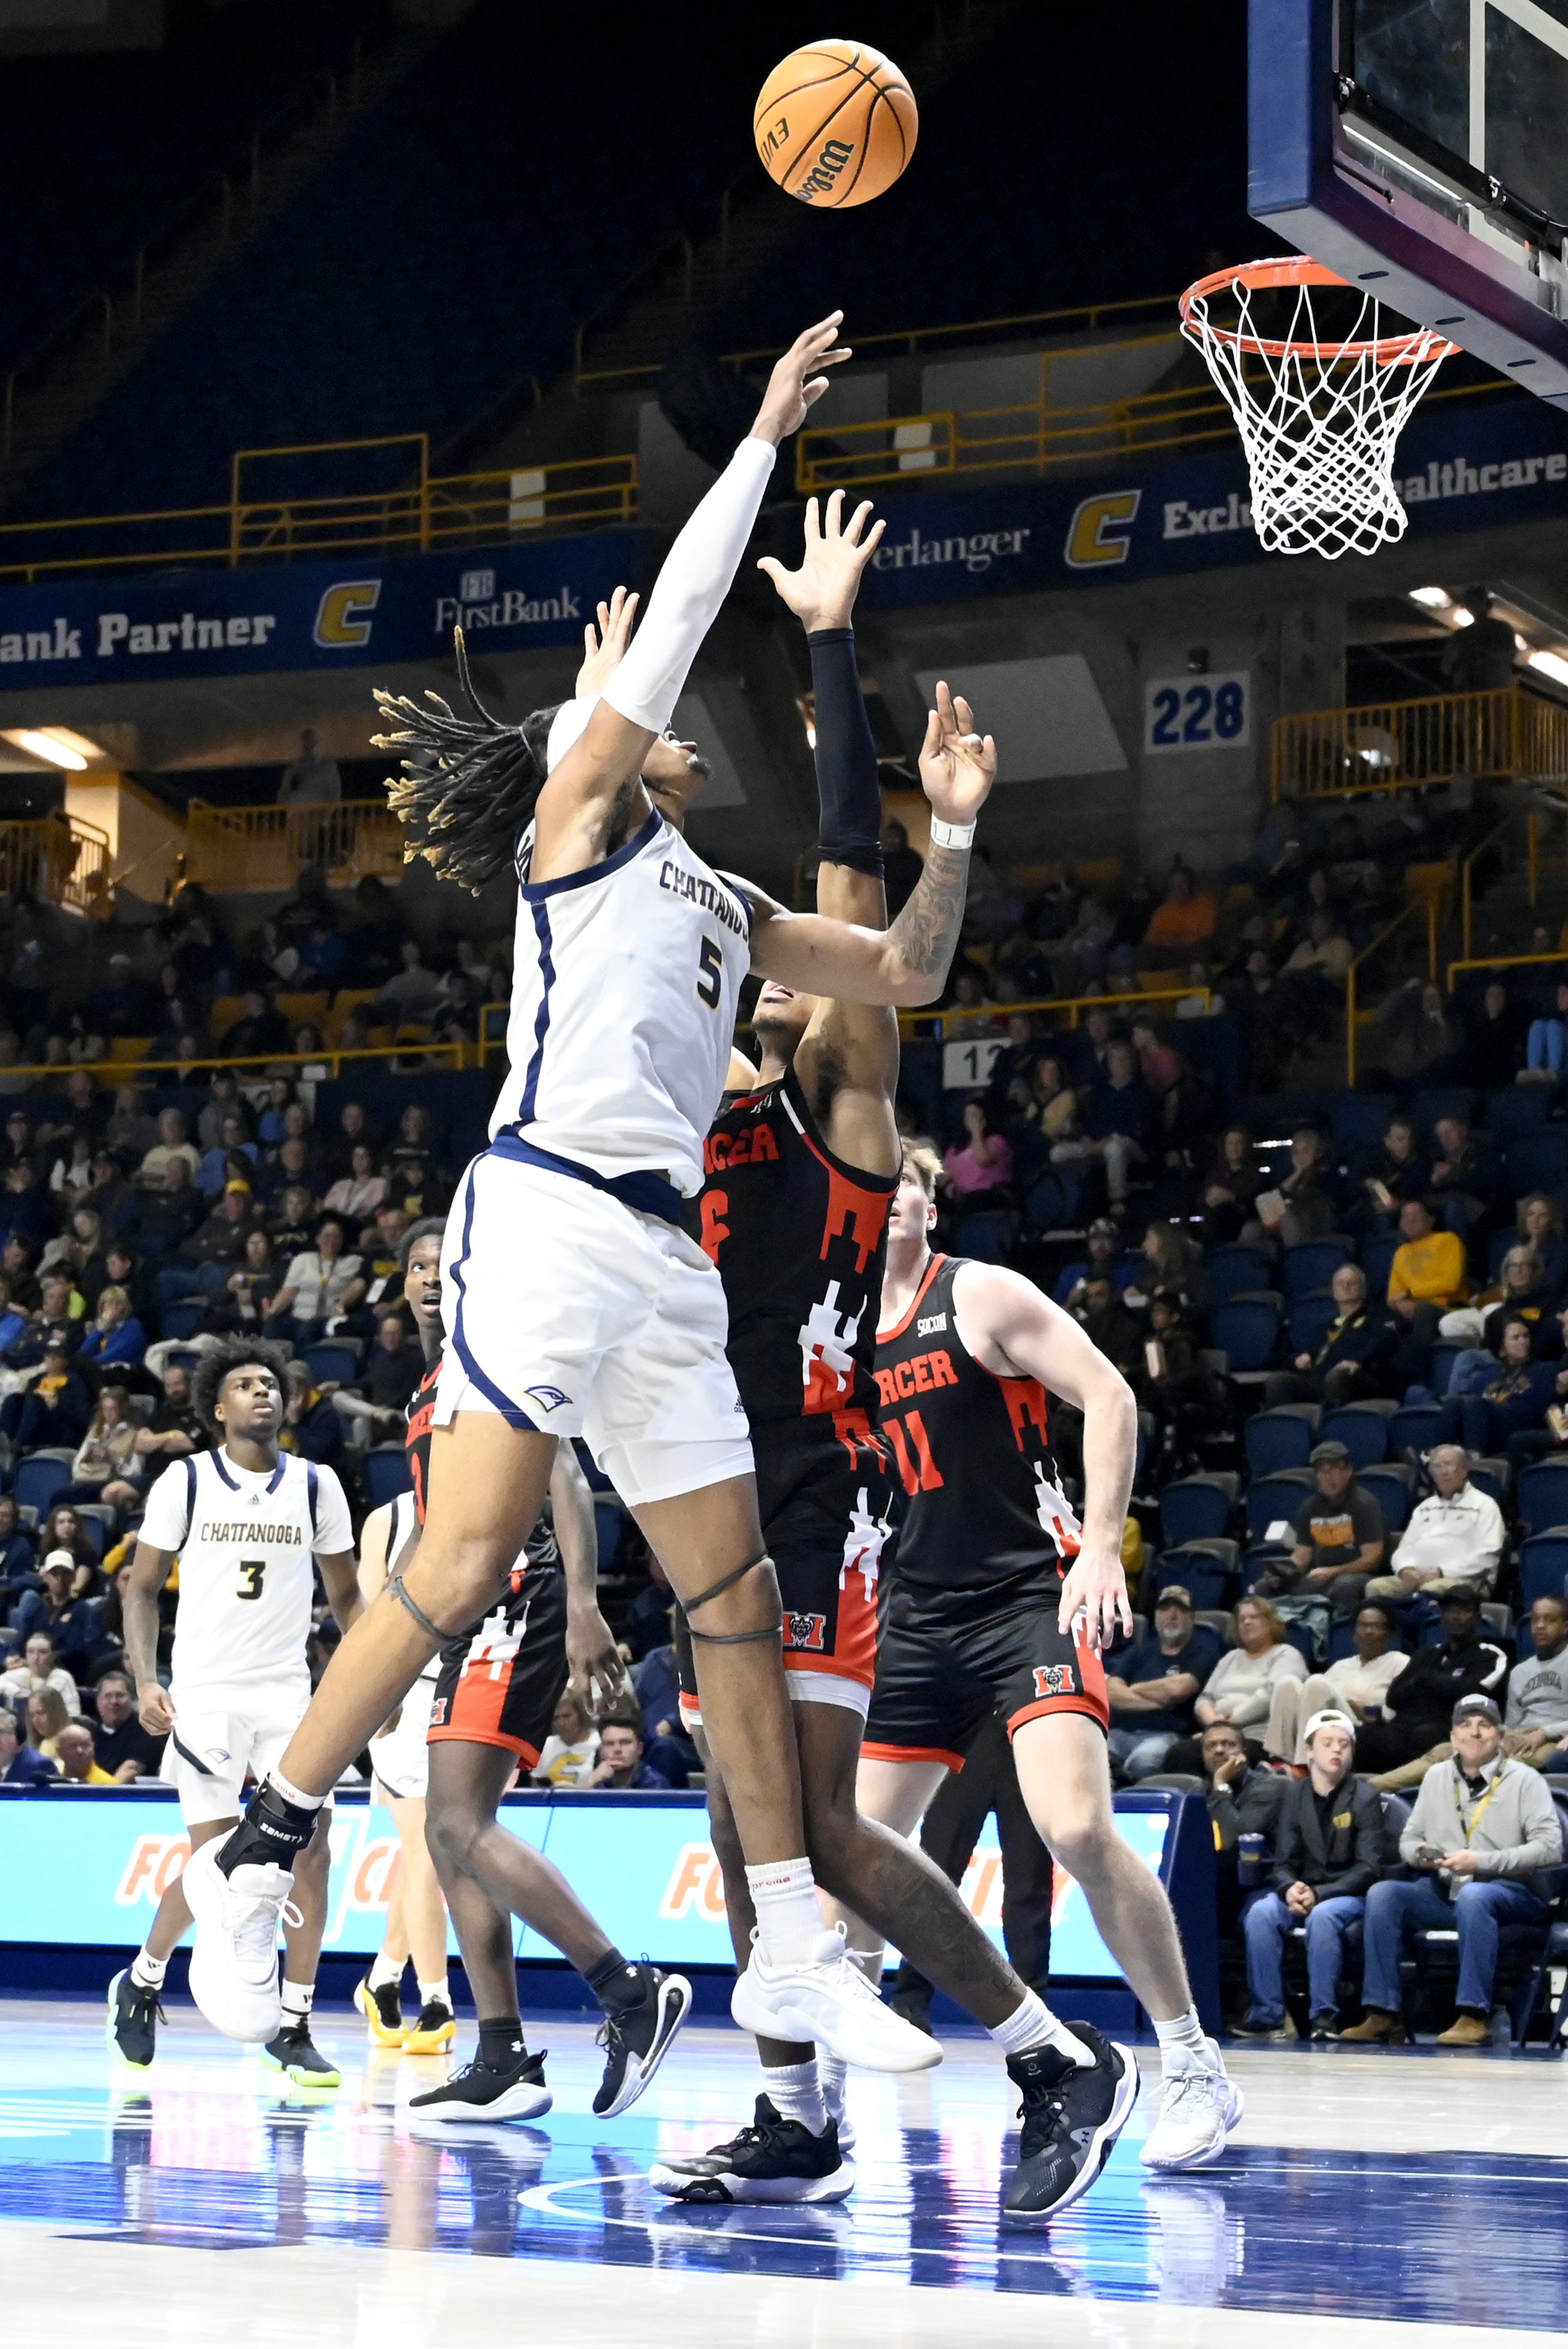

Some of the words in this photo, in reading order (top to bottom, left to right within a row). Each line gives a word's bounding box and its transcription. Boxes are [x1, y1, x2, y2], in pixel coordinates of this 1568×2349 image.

[435, 585, 581, 633] FirstBank
[97, 613, 276, 656] Partner
[1152, 681, 1244, 746] 228
[659, 861, 749, 943] CHATTANOO
[697, 934, 722, 1010] 5
[917, 1312, 947, 1338] SOCON
[881, 1410, 945, 1496] 11
[201, 1522, 302, 1546] CHATTANOOGA
[236, 1559, 266, 1600] 3
